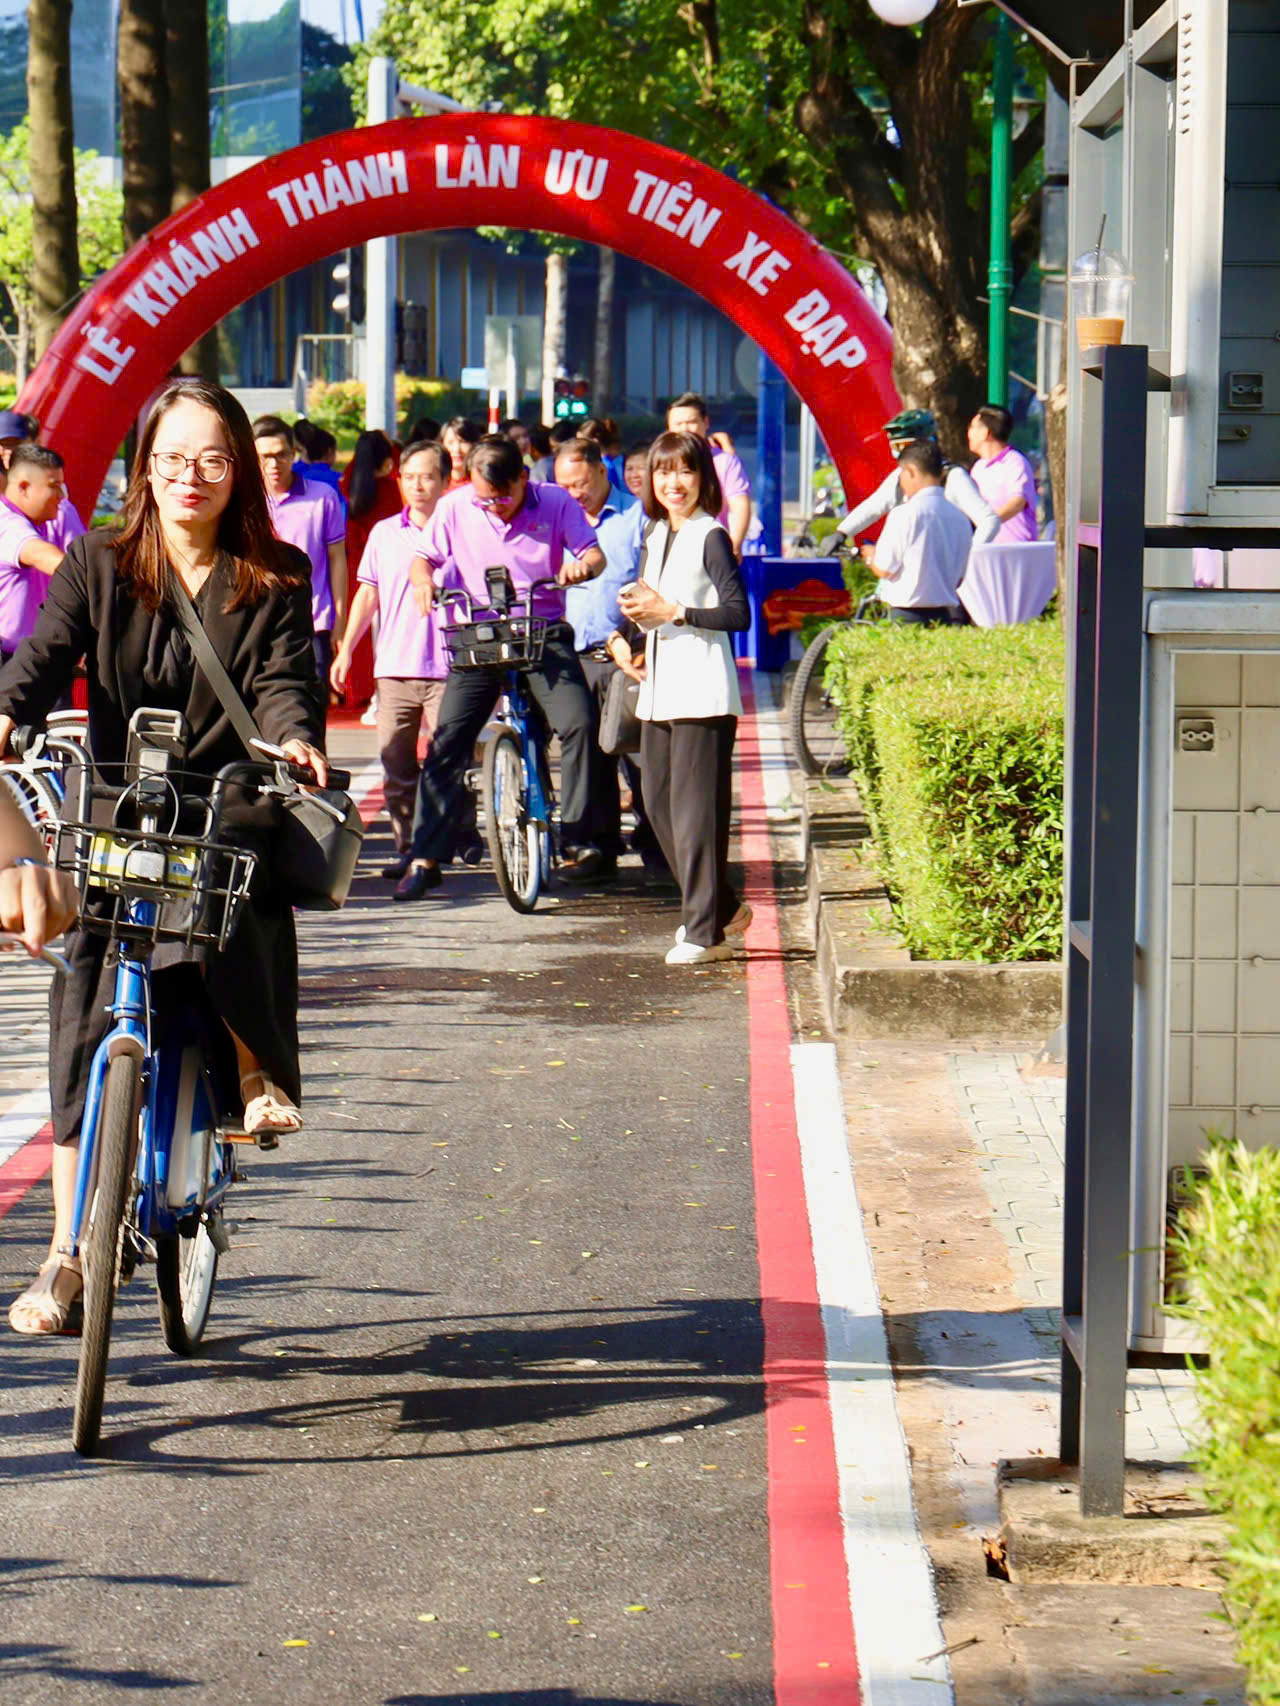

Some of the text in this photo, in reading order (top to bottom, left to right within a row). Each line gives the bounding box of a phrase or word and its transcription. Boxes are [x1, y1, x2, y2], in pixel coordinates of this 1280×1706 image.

[76, 135, 869, 386] LỄ KHÁNH THÀNH LÀN ƯU TIÊN XE ĐẠP
